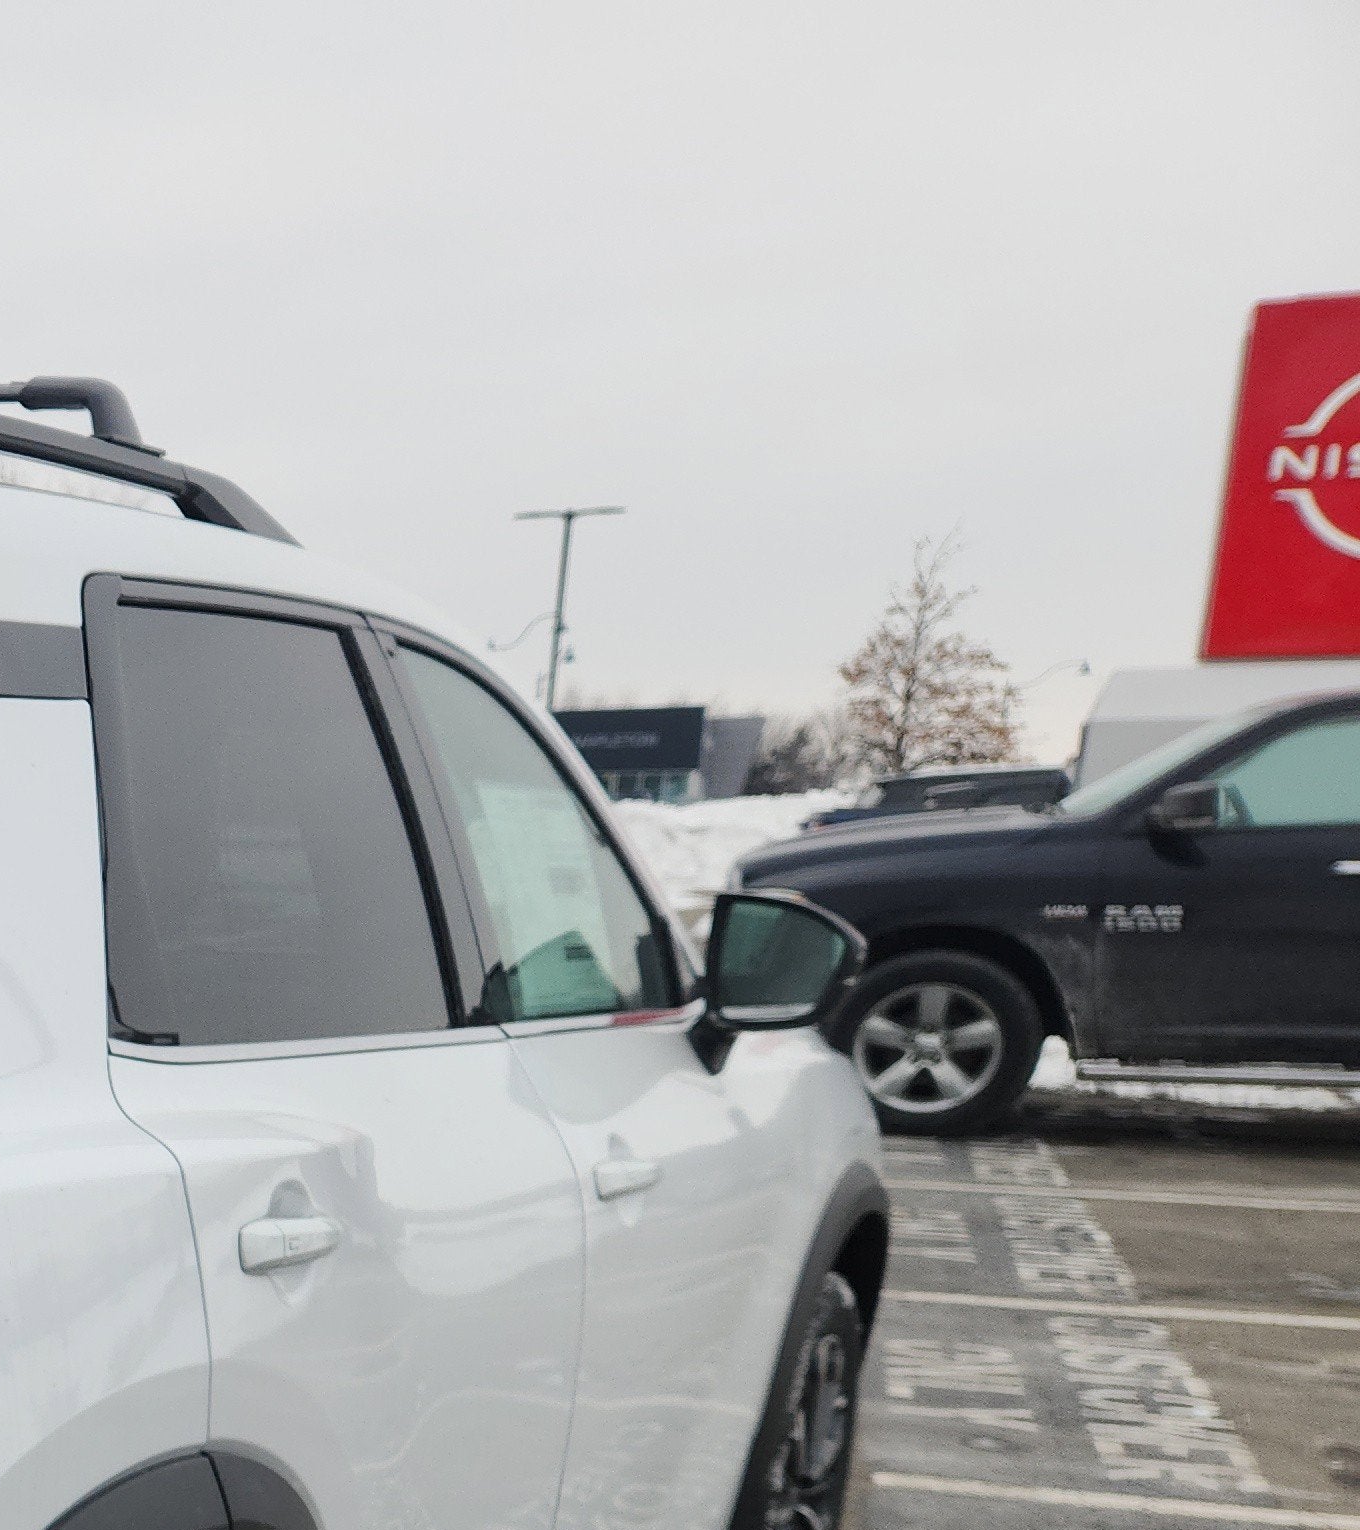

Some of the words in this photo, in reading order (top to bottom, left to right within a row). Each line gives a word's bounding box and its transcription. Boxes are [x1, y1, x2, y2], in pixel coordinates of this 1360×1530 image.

[1105, 904, 1185, 918] RAM
[883, 1340, 1041, 1433] ONLY
[1048, 1316, 1275, 1495] CUSTOMER
